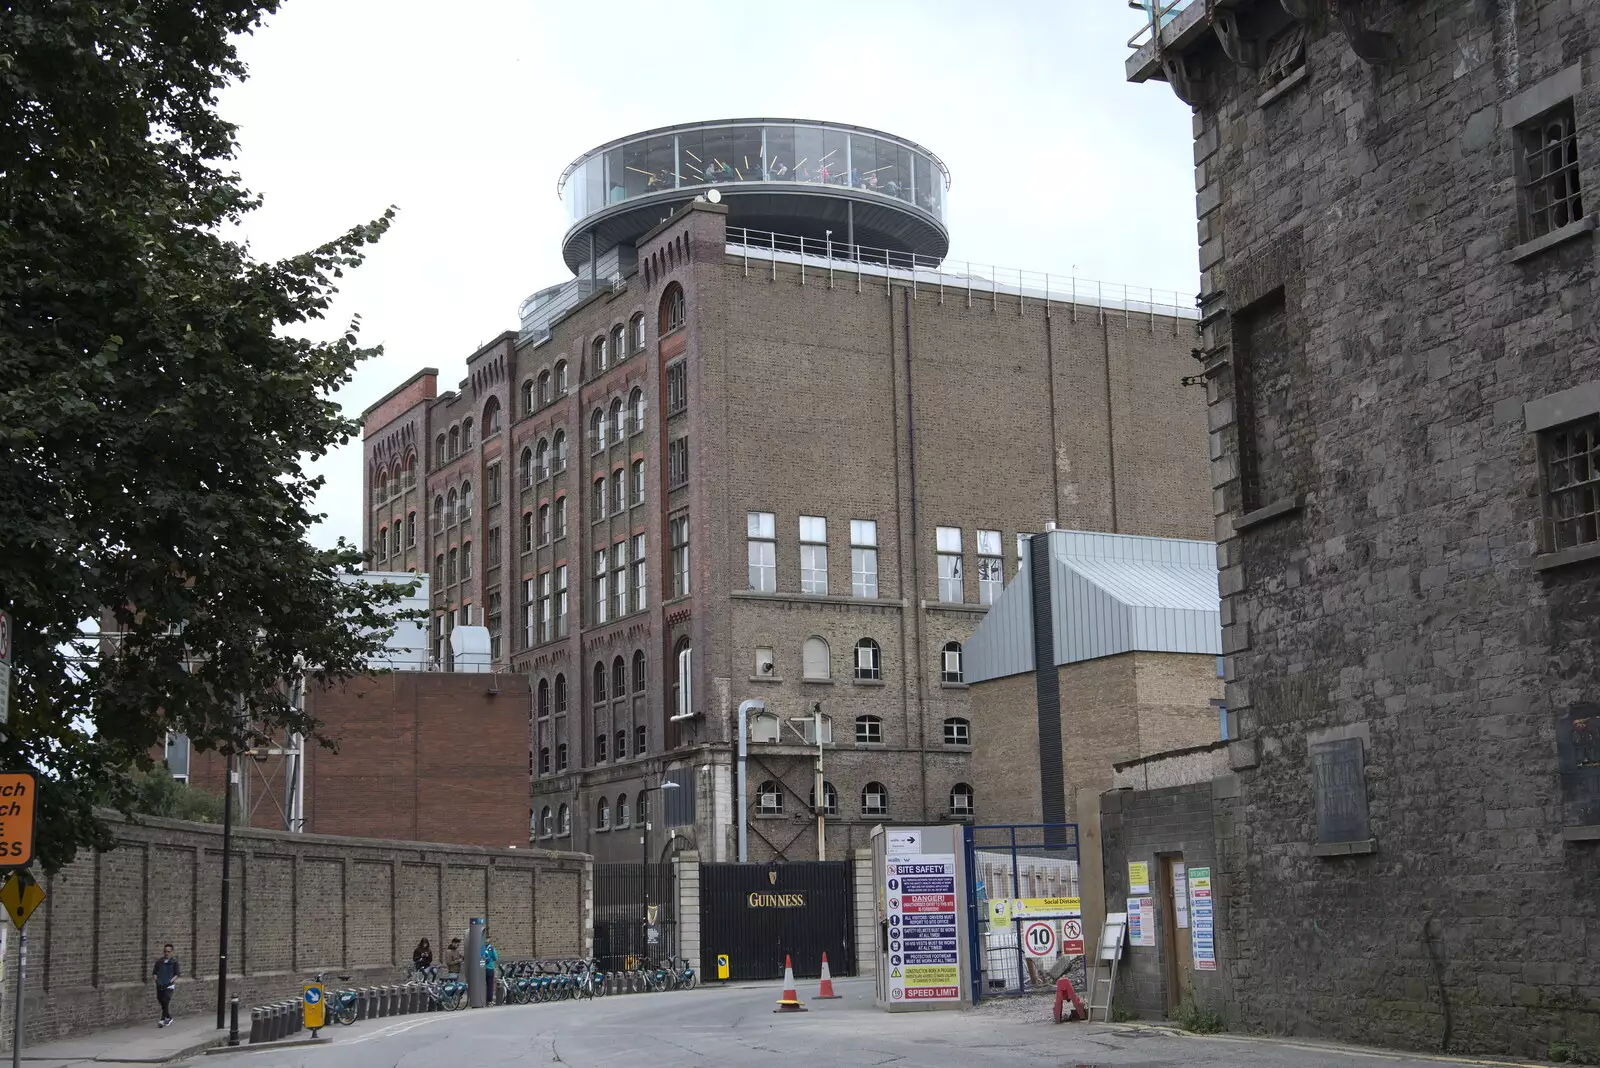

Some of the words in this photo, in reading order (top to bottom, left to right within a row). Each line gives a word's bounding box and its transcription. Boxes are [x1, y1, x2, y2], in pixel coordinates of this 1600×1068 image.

[916, 865, 943, 873] SAFETY
[750, 893, 804, 907] GUINNESS
[1030, 929, 1049, 945] 10
